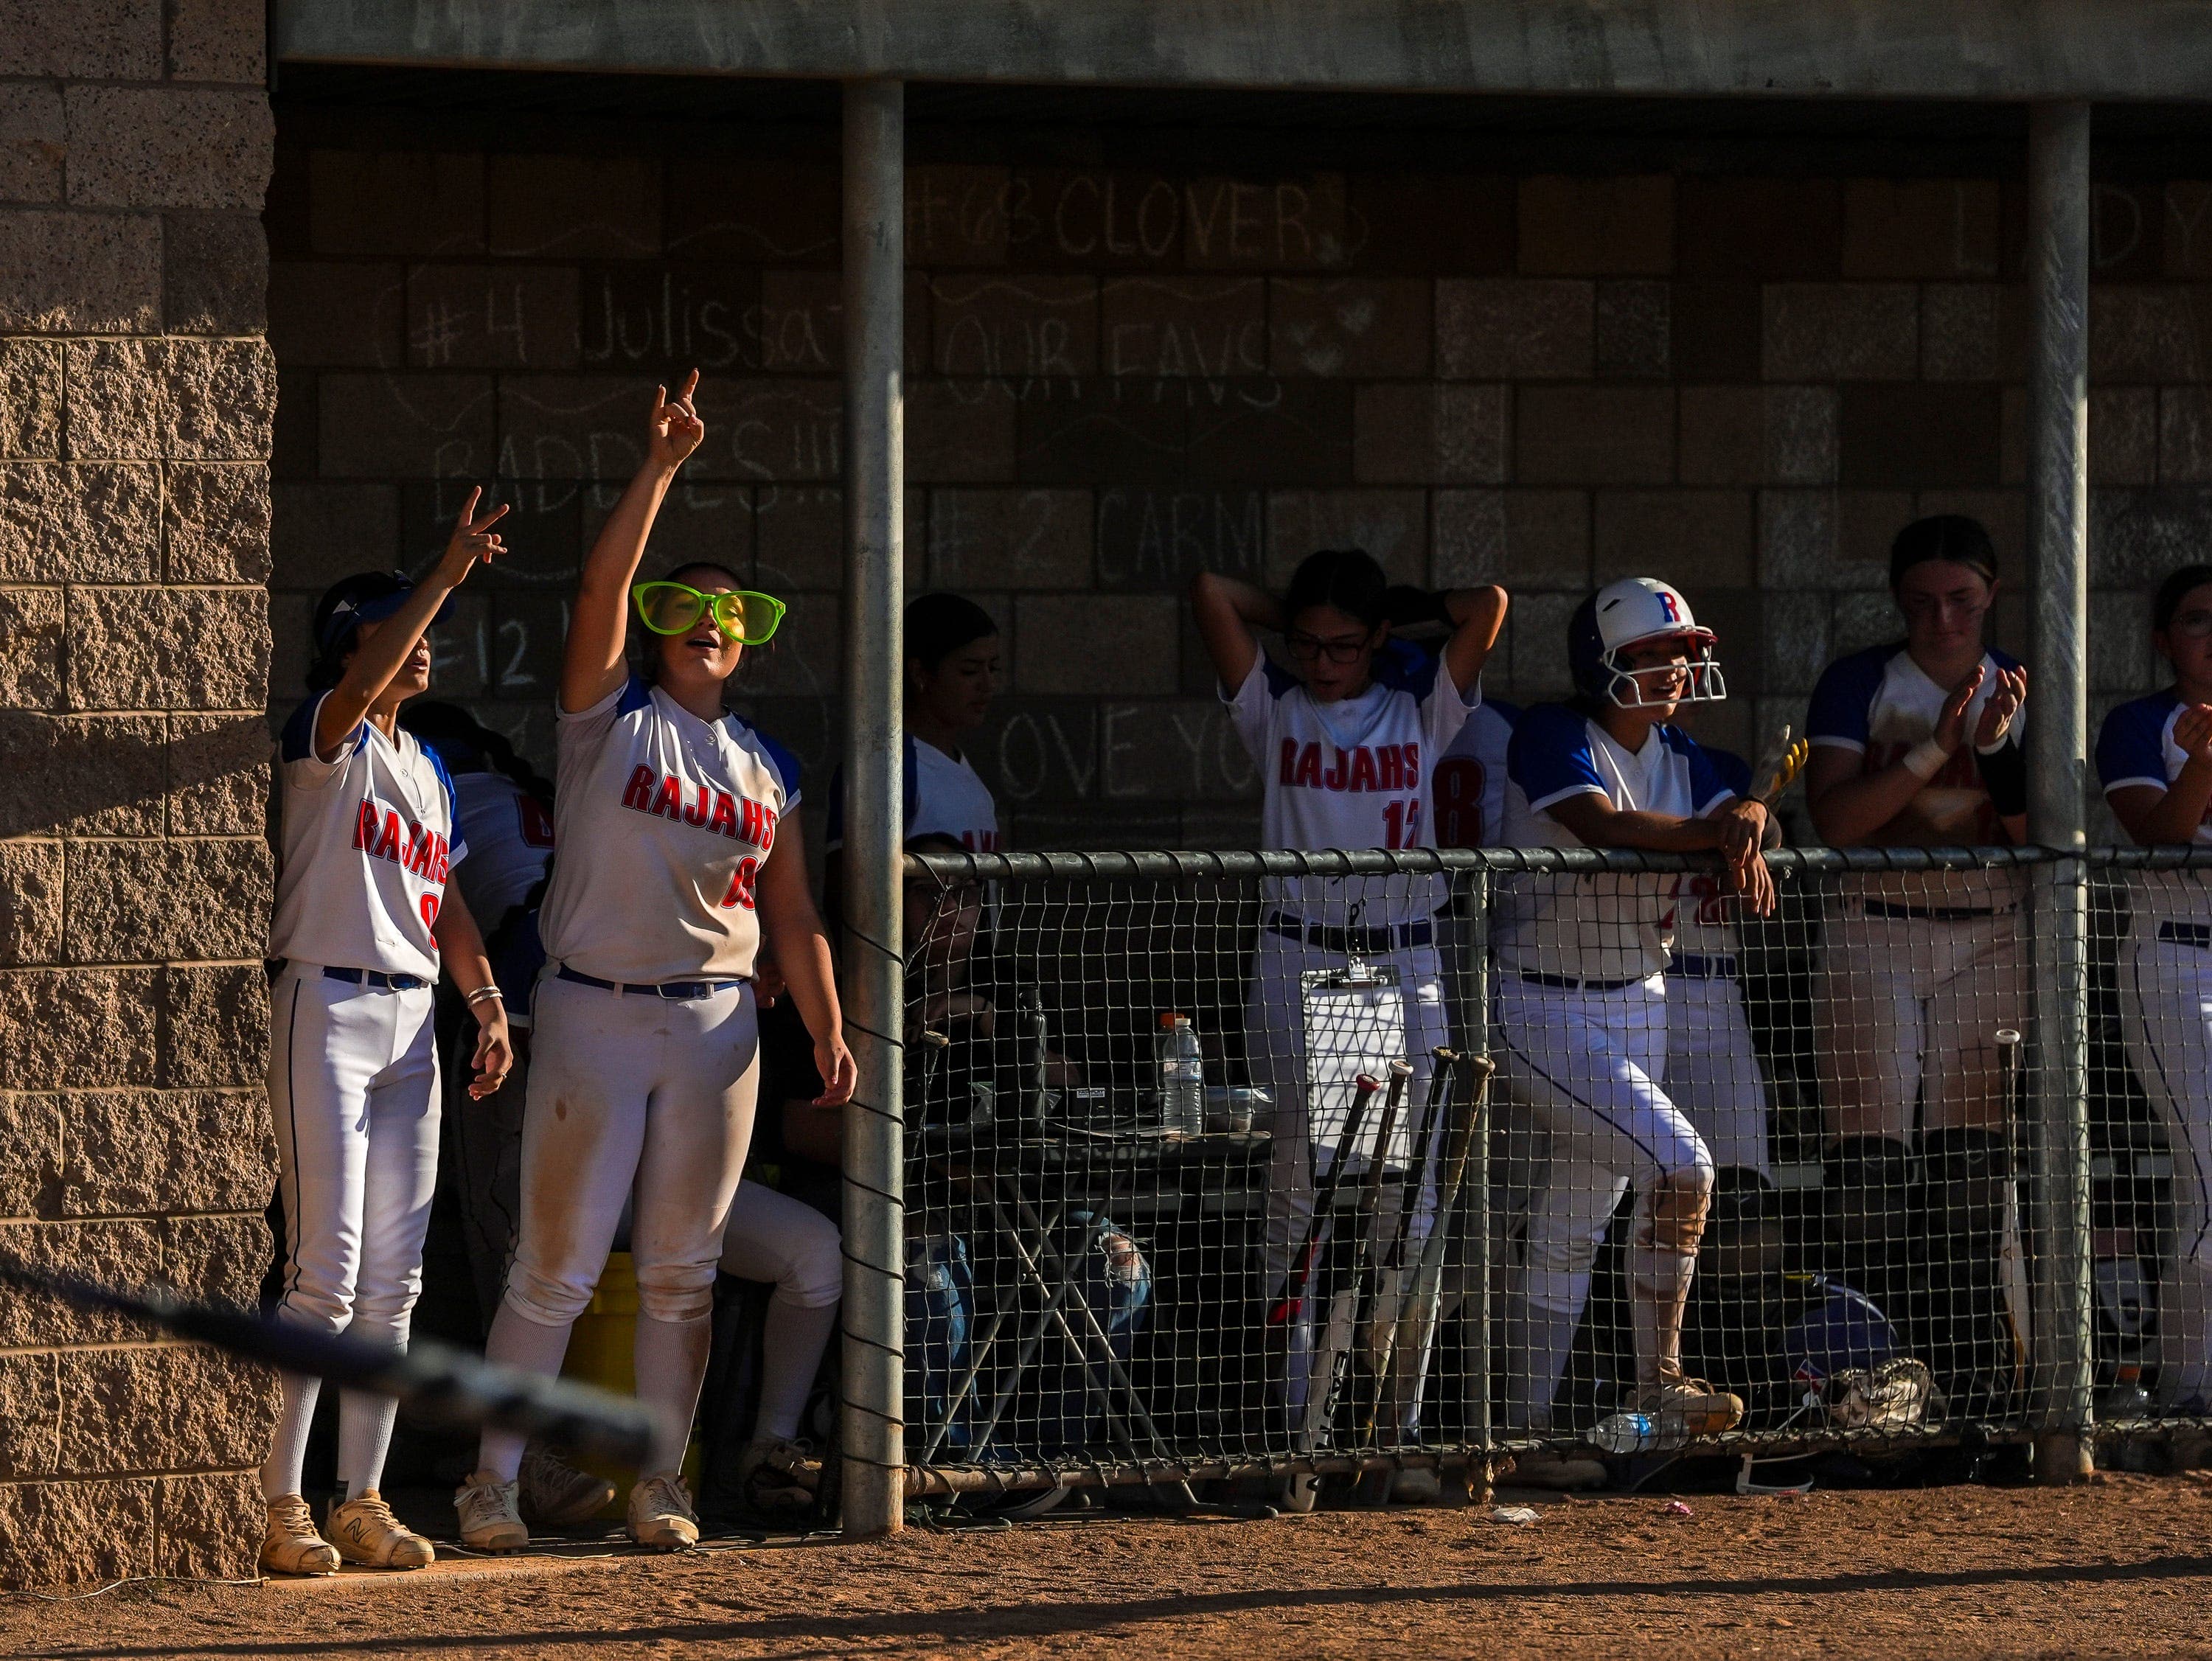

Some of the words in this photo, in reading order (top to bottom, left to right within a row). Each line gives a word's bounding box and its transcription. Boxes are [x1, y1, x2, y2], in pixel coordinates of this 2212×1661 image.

[1056, 175, 1312, 260] CLOVER
[575, 271, 830, 369] Julissa
[944, 314, 1080, 405] OUR
[1110, 321, 1283, 408] FAVS
[1655, 592, 1681, 622] R
[998, 704, 1150, 801] OVE
[1280, 737, 1419, 793] RAJAHS
[621, 763, 777, 852] RAJAHS
